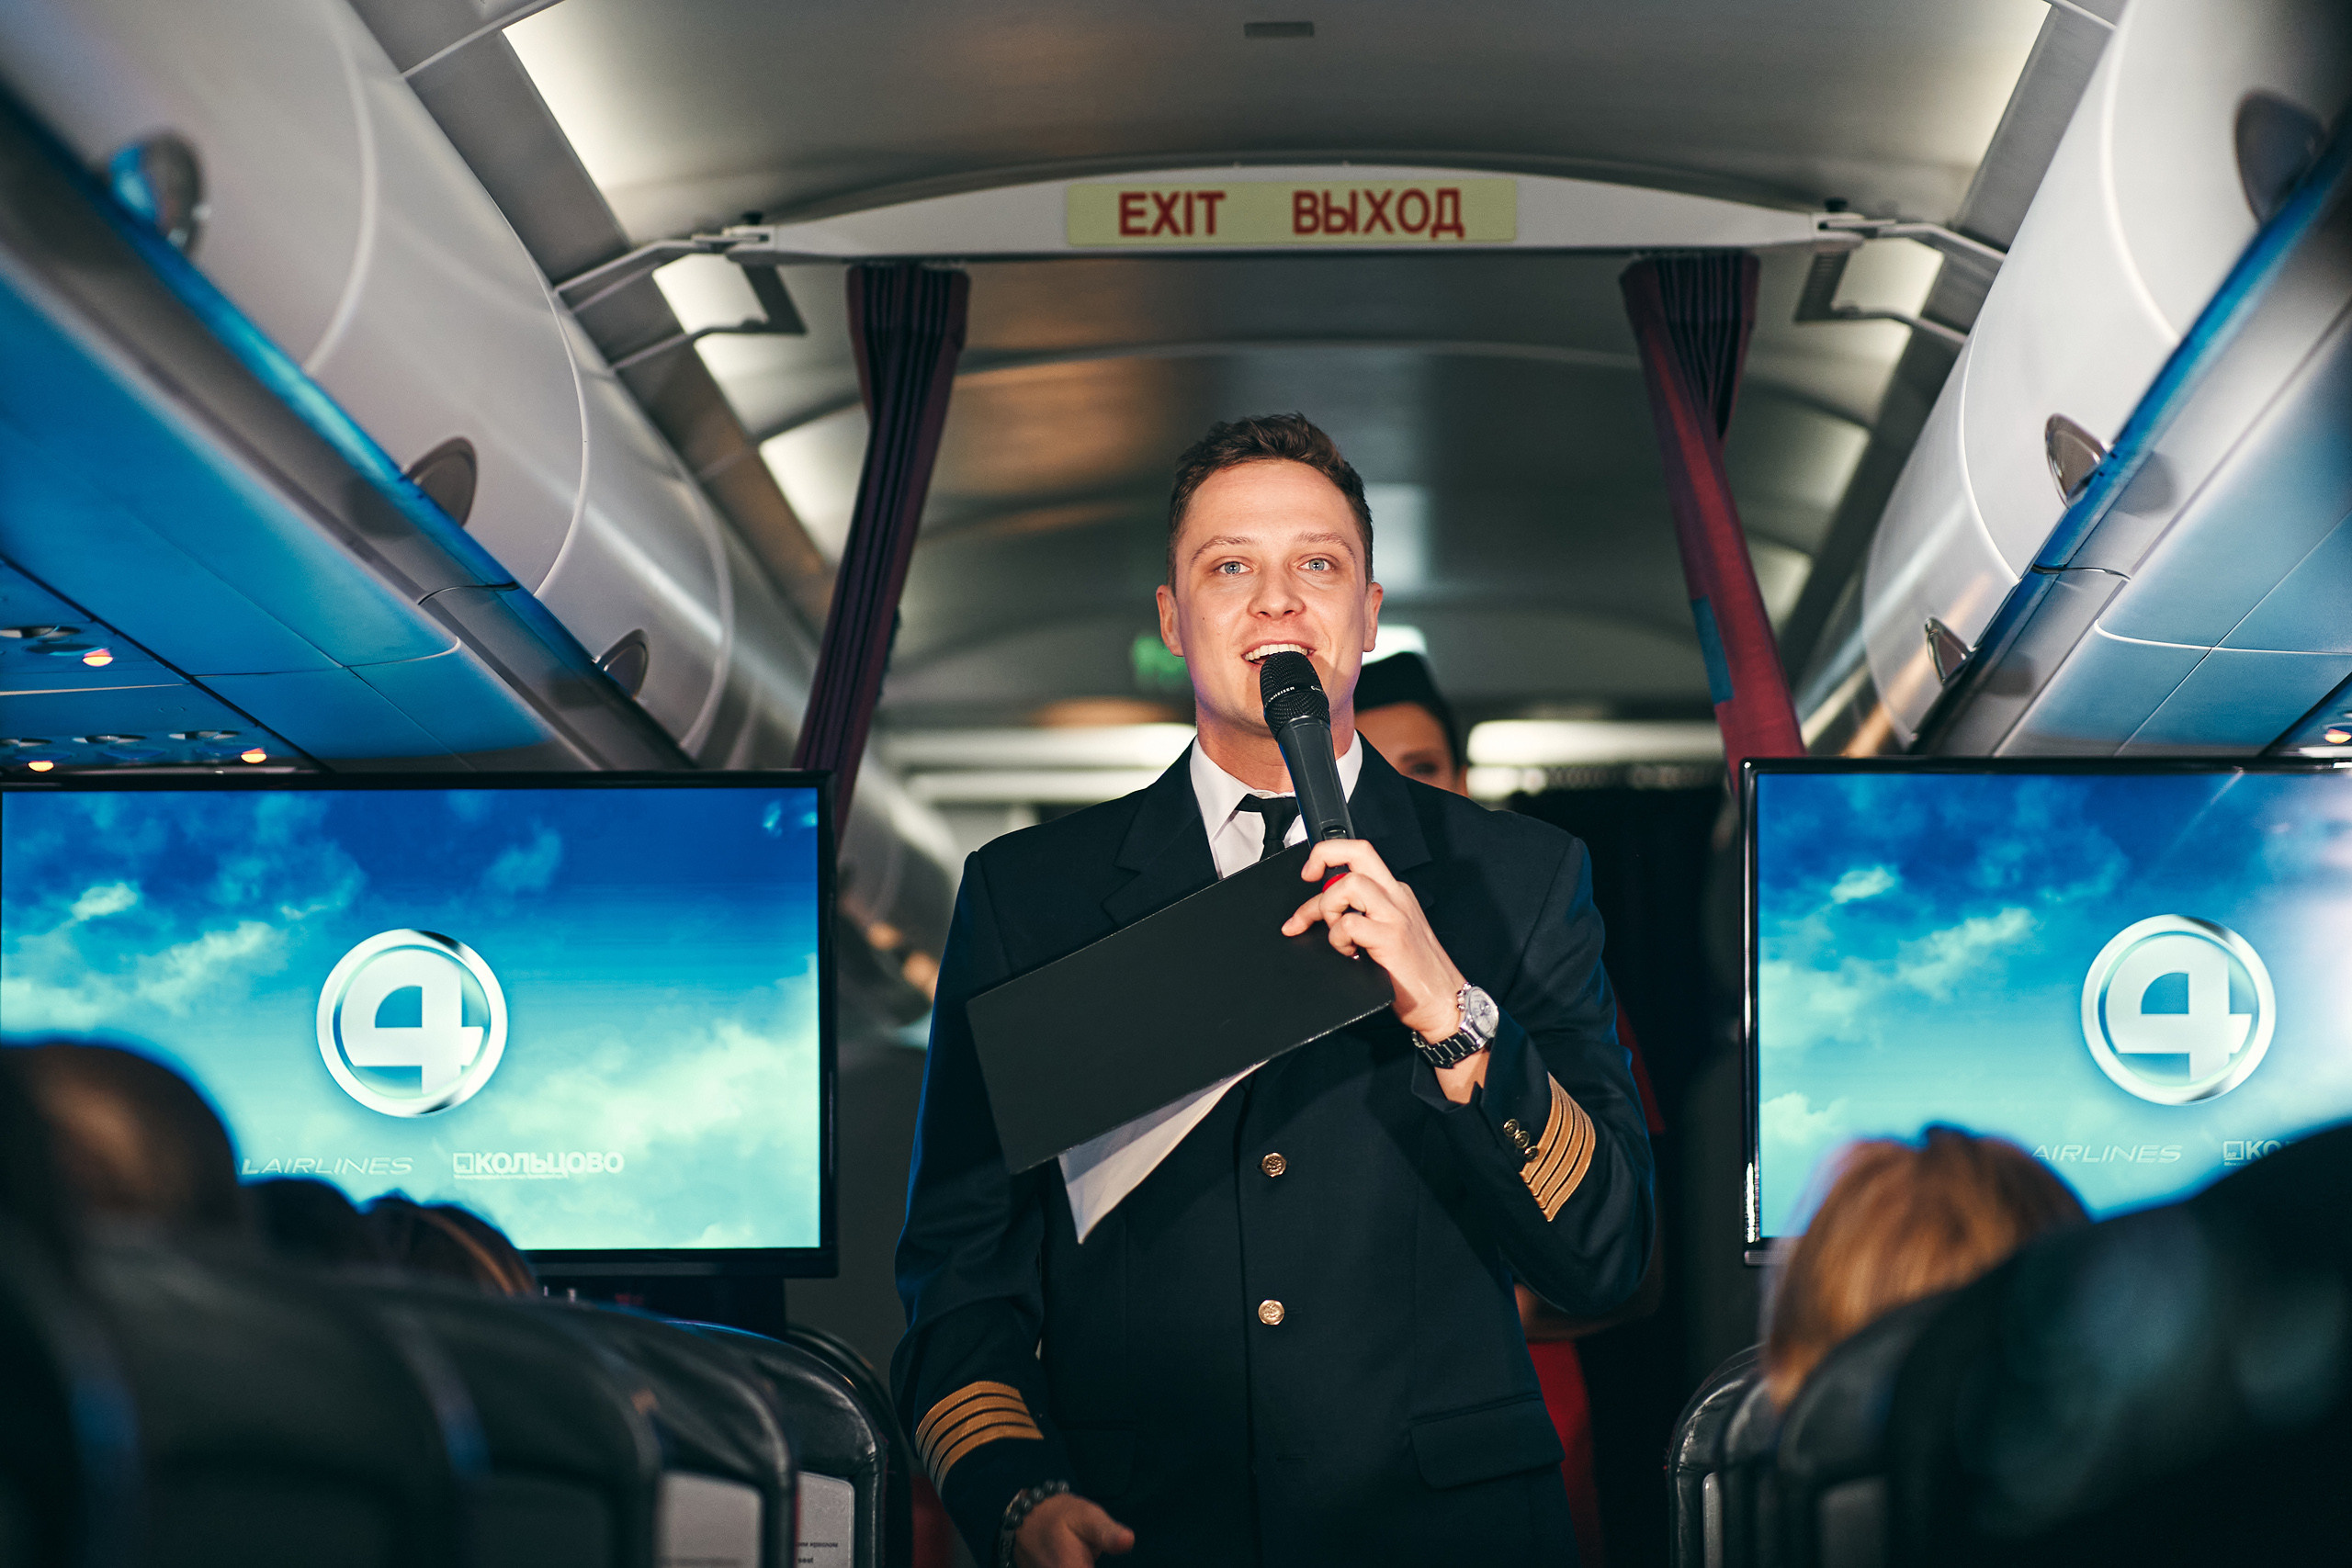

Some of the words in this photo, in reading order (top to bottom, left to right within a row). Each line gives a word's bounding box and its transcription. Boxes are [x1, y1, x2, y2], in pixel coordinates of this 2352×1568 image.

[1118, 190, 1227, 237] EXIT
[1293, 188, 1465, 239] ВЫХОД
[340, 948, 484, 1095] 4
[2105, 935, 2253, 1082] 4
[240, 1156, 414, 1176] LAIRLINES
[475, 1151, 625, 1177] КОЛЬЦОВО
[2031, 1144, 2183, 1164] AIRLINES
